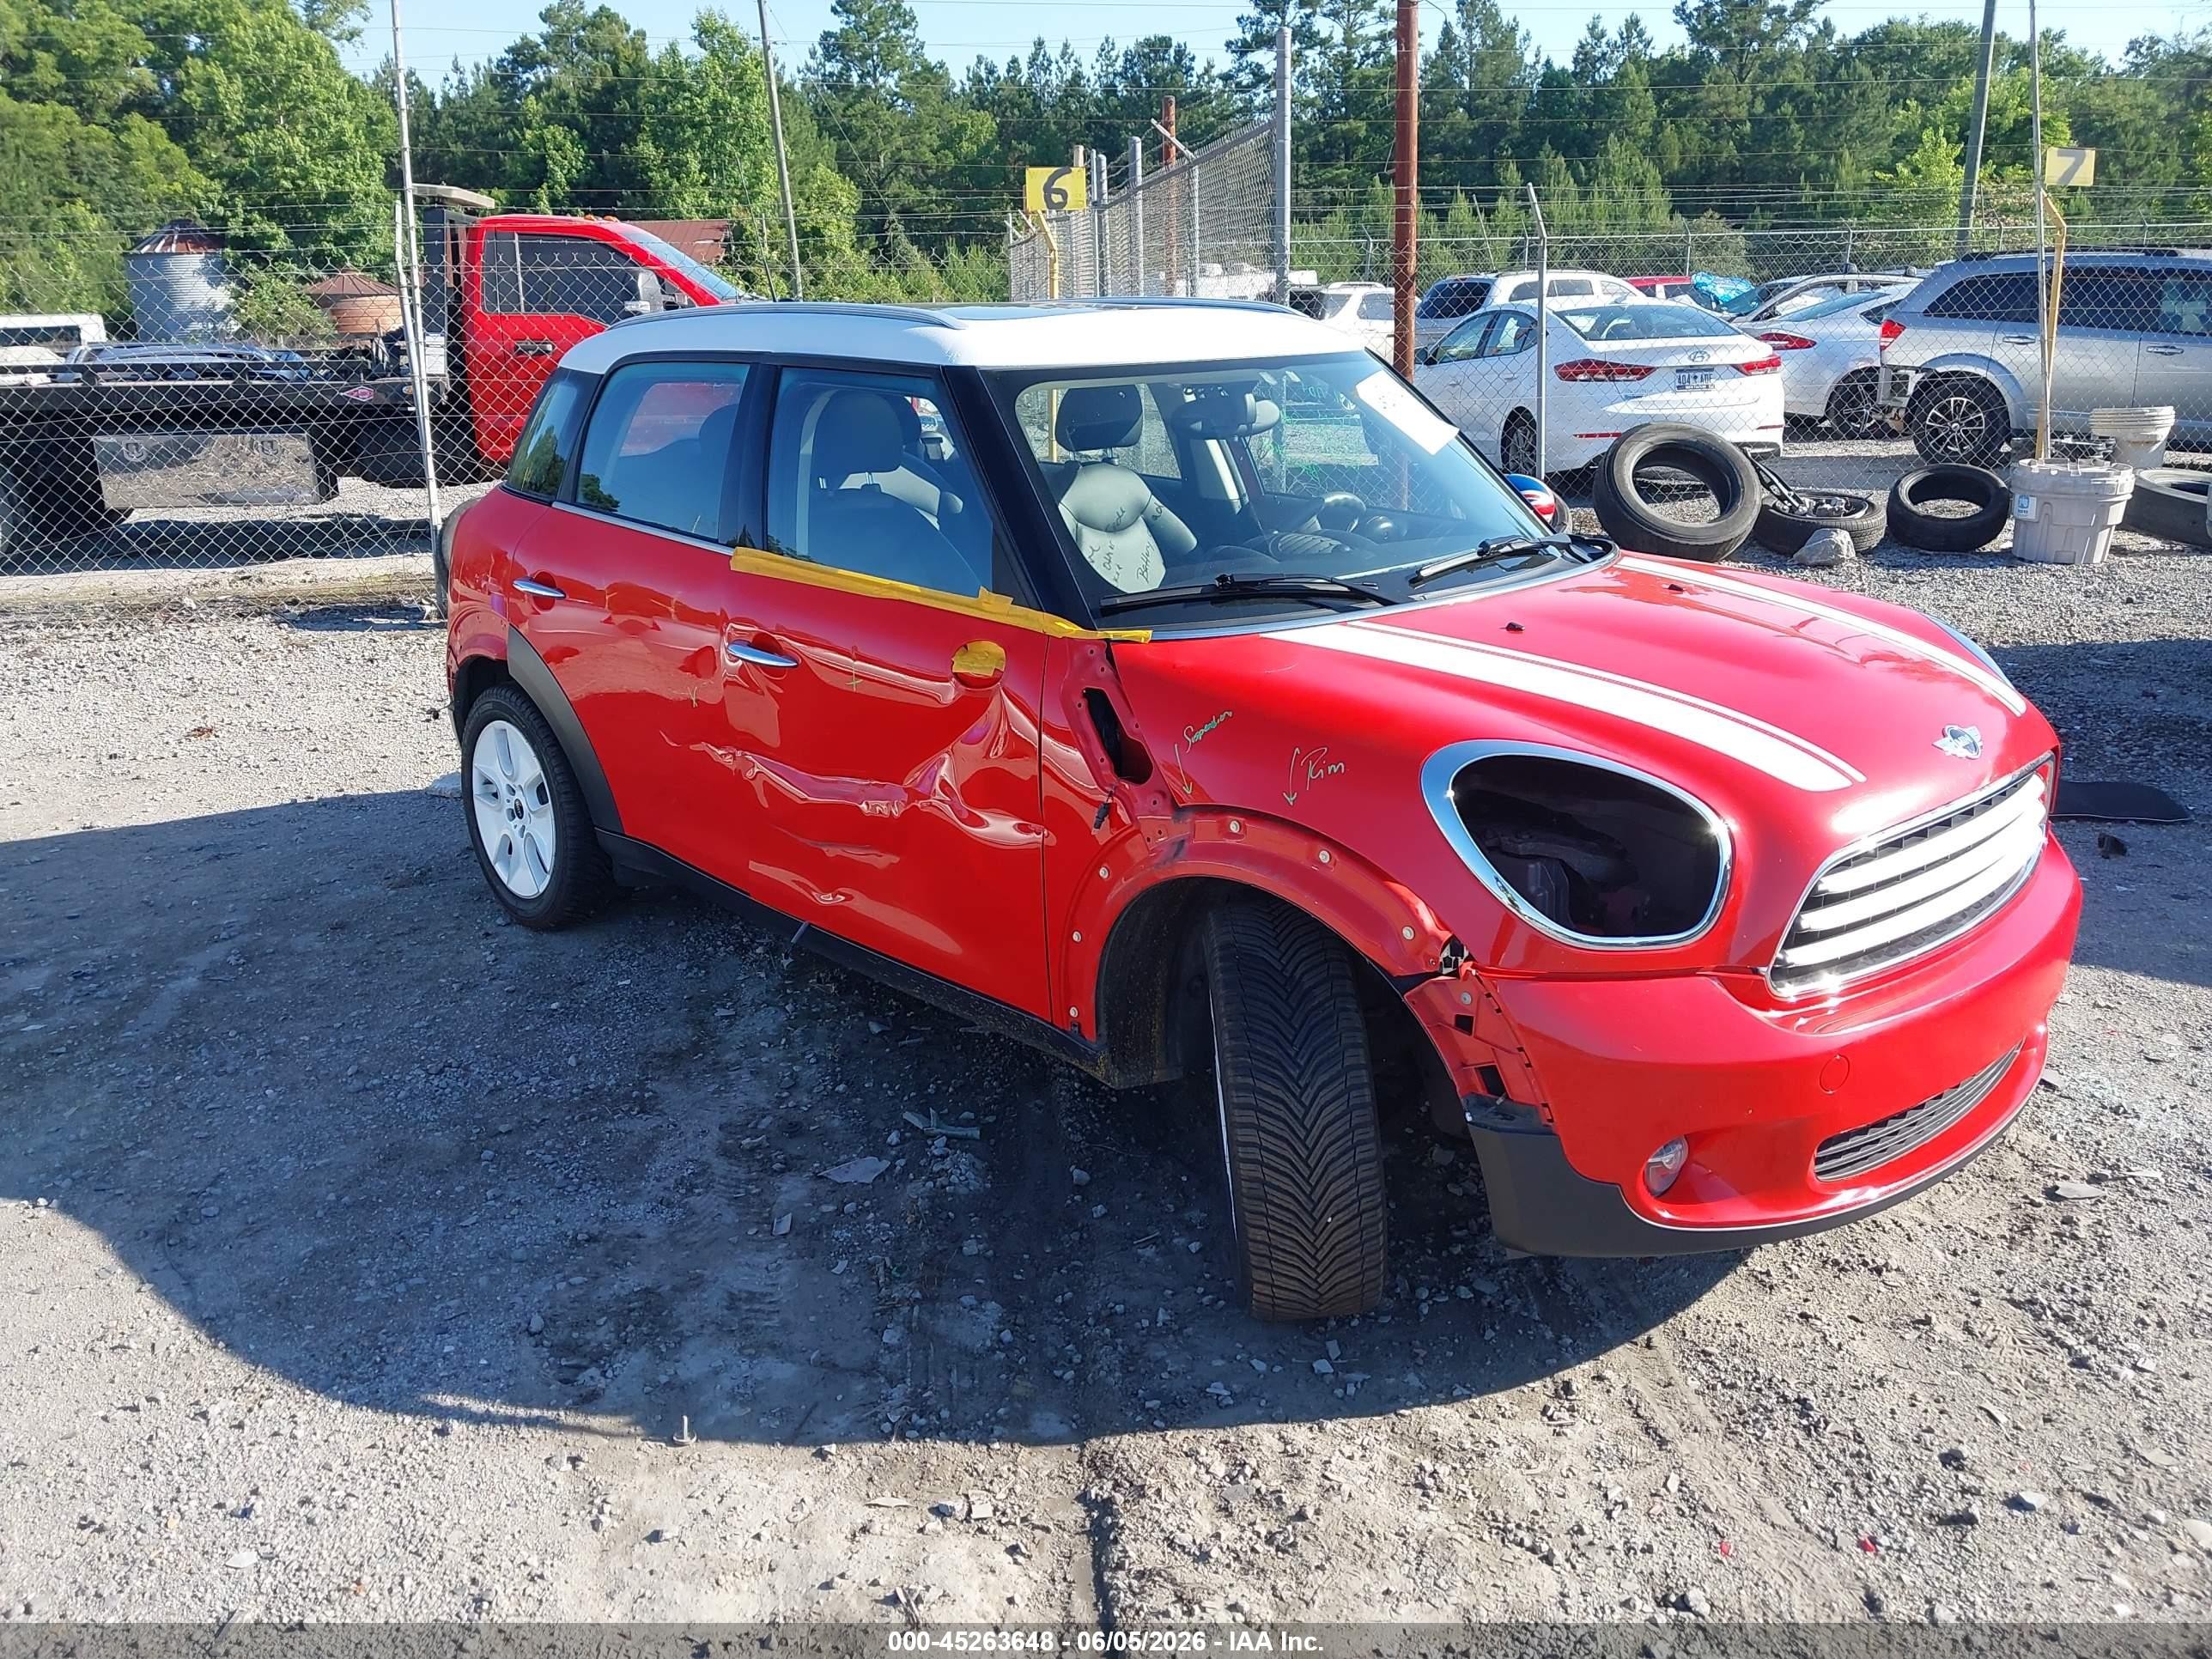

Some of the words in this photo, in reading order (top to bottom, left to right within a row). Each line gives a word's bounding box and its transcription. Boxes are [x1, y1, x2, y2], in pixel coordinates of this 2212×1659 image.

[1043, 166, 1072, 210] 6
[2057, 148, 2086, 185] 7
[1301, 747, 1345, 790] Rim
